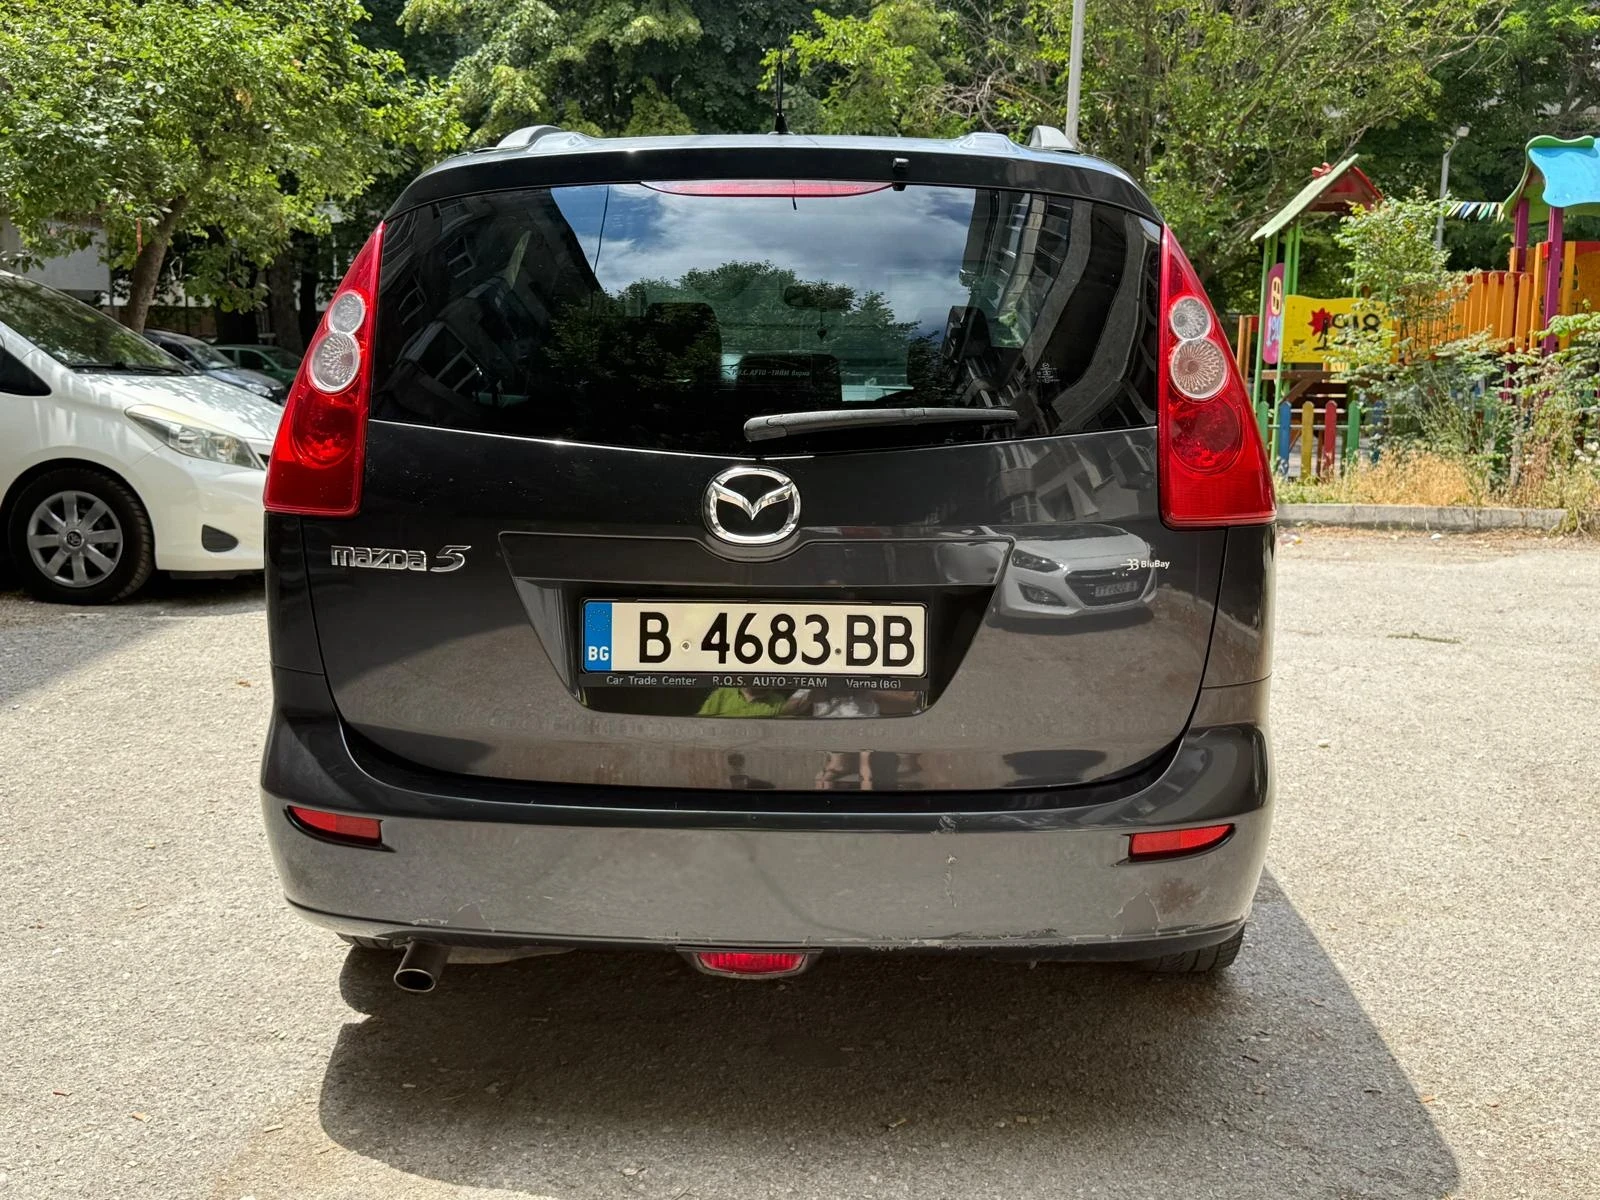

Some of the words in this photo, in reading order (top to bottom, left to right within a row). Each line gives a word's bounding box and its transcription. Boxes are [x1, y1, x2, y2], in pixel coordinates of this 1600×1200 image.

[430, 545, 472, 573] 5
[1140, 559, 1170, 570] BluBay
[638, 611, 671, 664] B
[700, 612, 831, 666] 4683
[845, 614, 915, 668] BB
[588, 645, 609, 661] BG
[606, 675, 624, 685] Car
[628, 675, 657, 686] Trade
[662, 675, 697, 686] Center
[845, 678, 877, 689] Varna
[879, 679, 901, 690] (BG)
